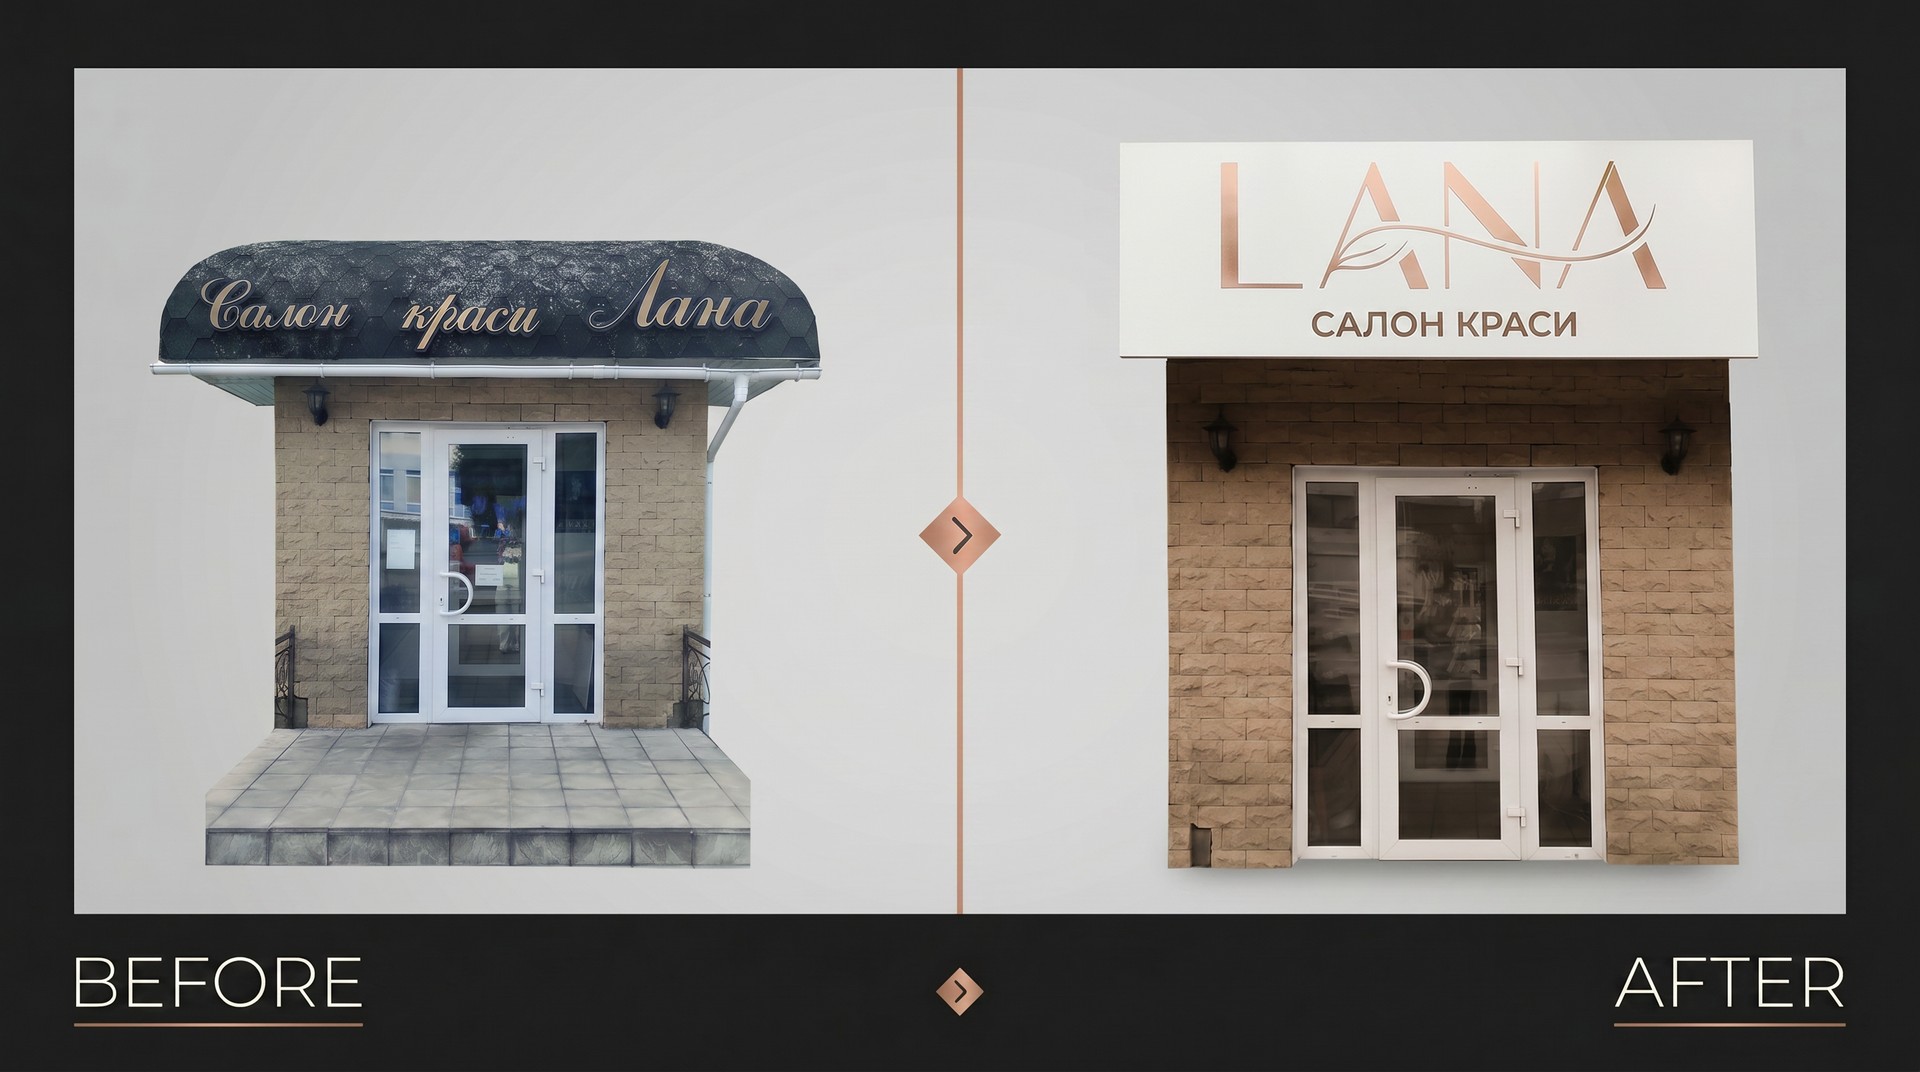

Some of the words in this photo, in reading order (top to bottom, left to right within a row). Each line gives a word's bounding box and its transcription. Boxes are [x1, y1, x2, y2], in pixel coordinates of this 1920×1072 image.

[1220, 160, 1667, 289] LANA
[200, 276, 352, 331] Салон
[402, 293, 541, 352] краси
[589, 258, 772, 330] Лана
[1311, 311, 1443, 337] САЛОН
[1457, 311, 1577, 337] КРАСИ
